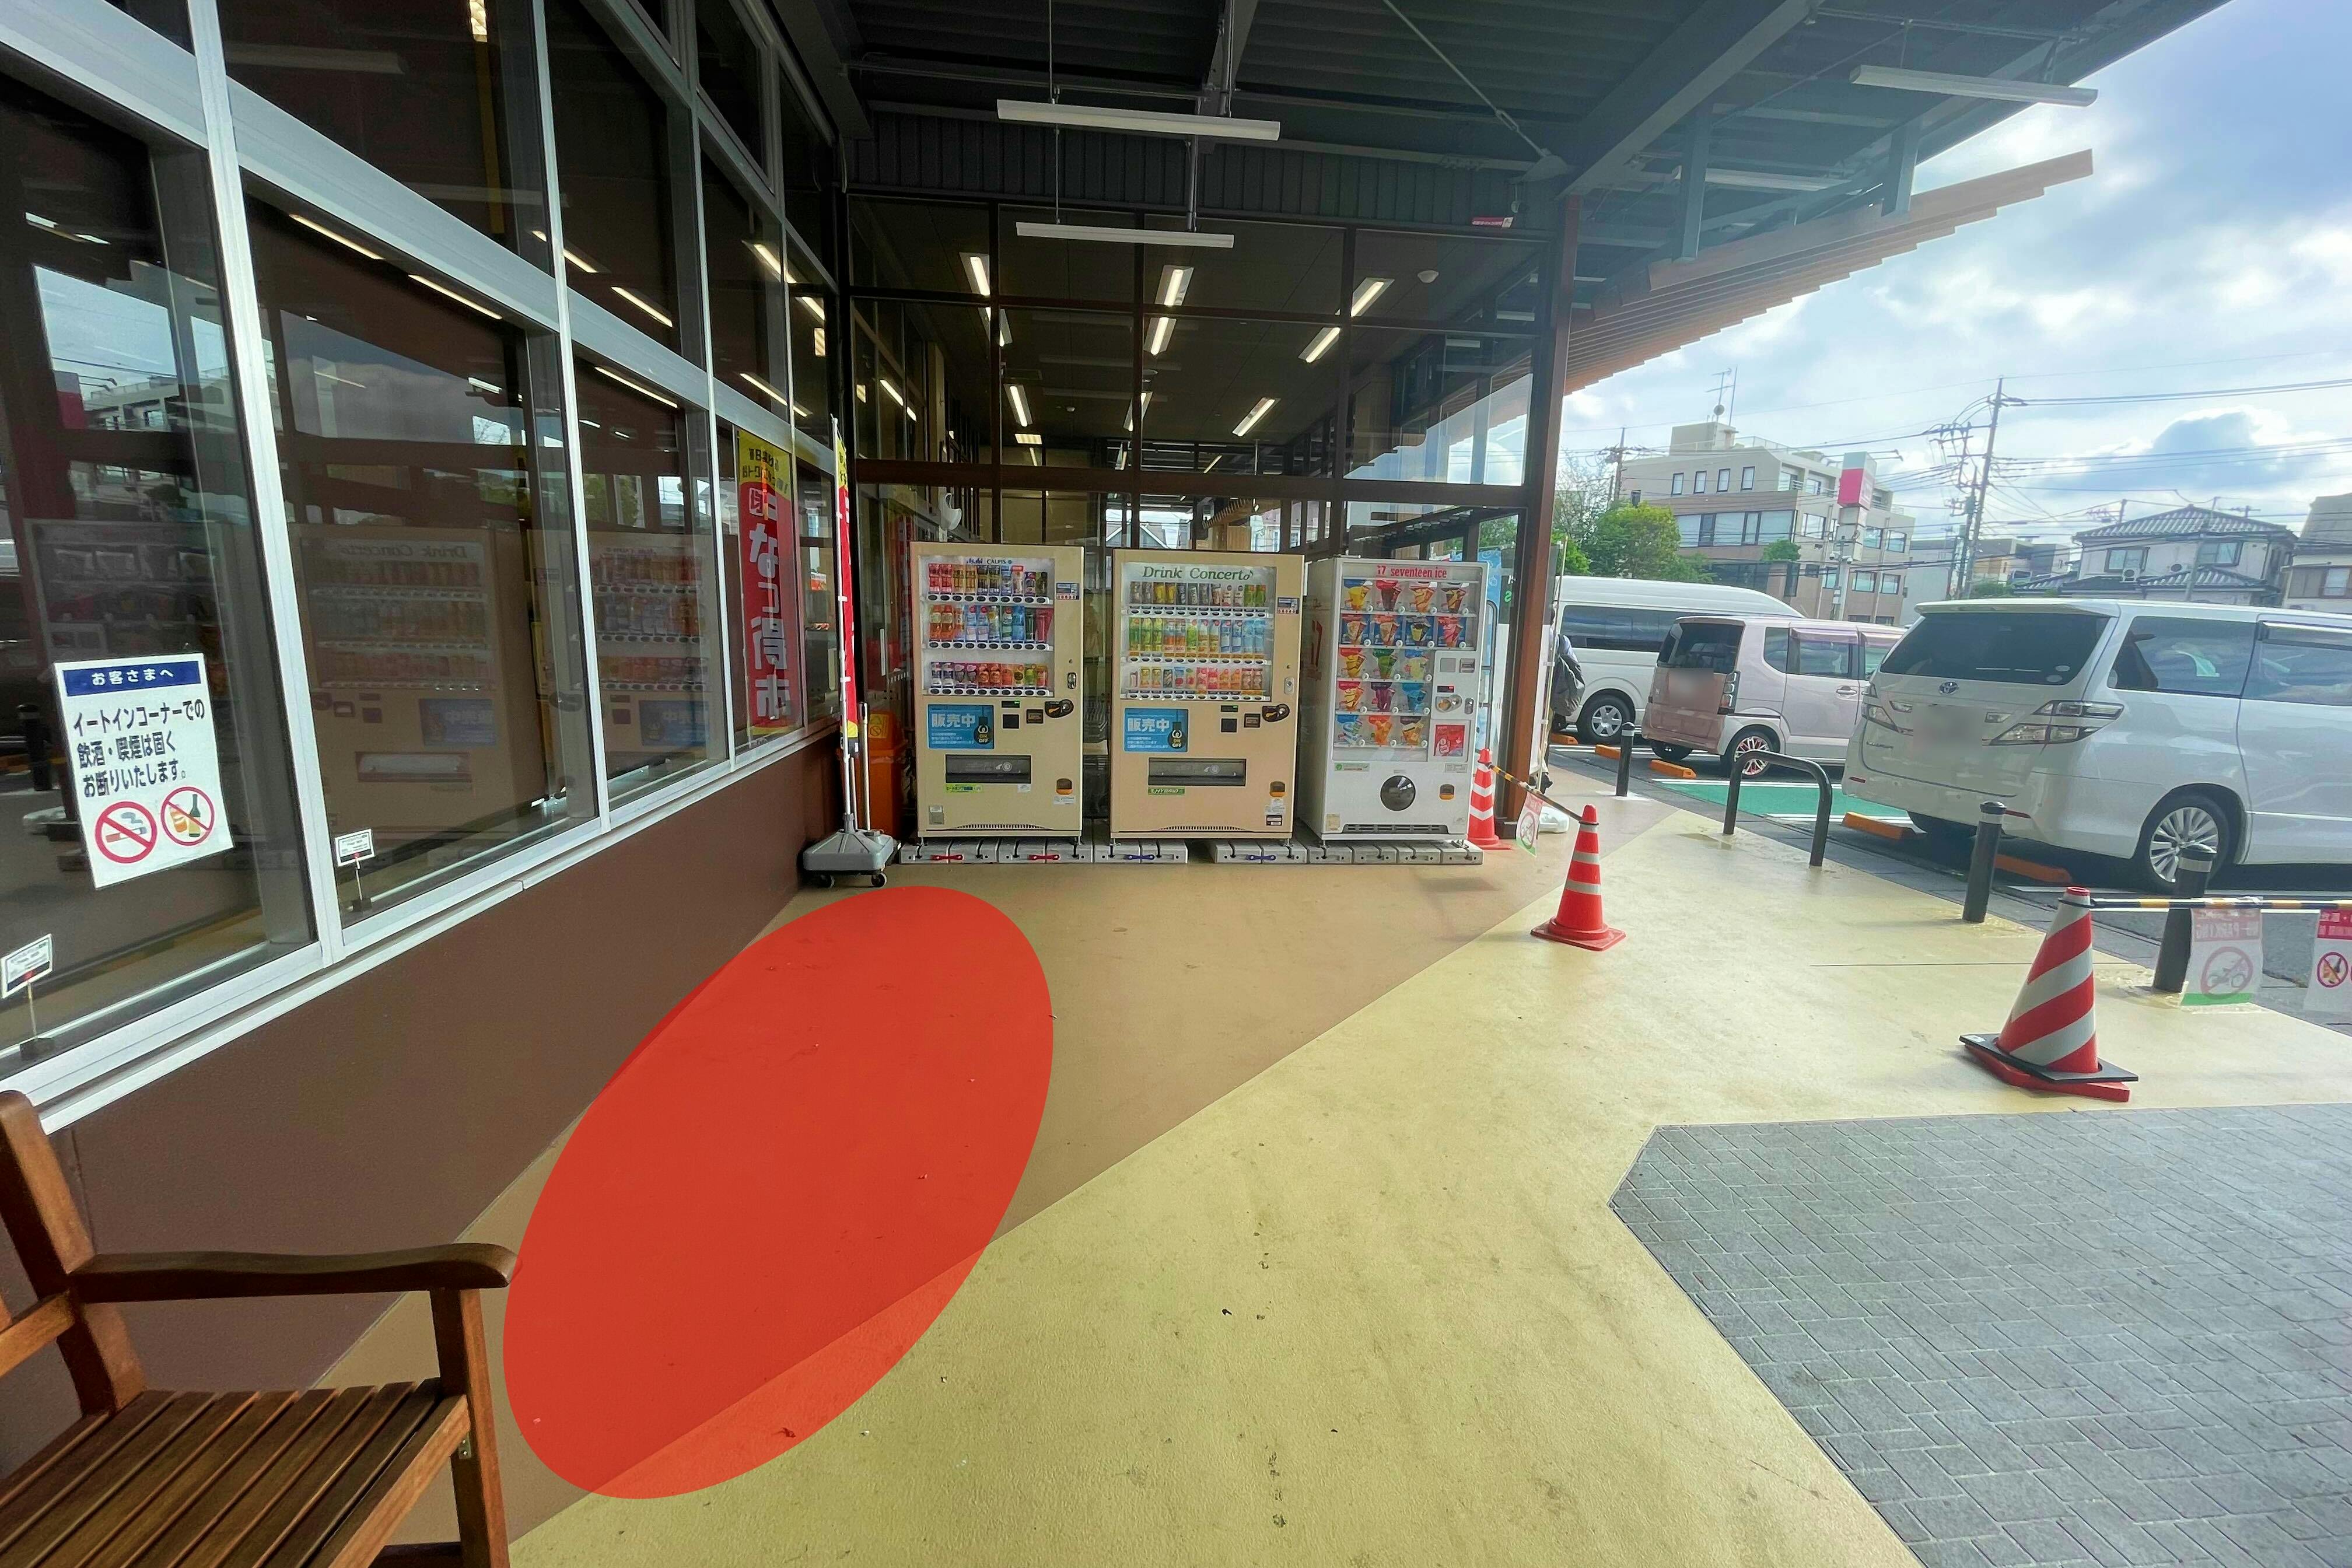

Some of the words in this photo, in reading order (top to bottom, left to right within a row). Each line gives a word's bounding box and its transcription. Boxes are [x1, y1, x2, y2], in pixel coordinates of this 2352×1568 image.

[1142, 566, 1182, 579] Drink
[1189, 567, 1251, 580] Concerto
[1390, 568, 1433, 579] seventeen
[1435, 566, 1447, 579] ice
[91, 668, 174, 687] お客さまへ
[73, 698, 205, 737] イートインコーナーでの
[932, 713, 975, 727] 販売中
[1127, 718, 1170, 732] 販売中
[76, 730, 176, 769] 飲酒・喫煙は固く
[83, 758, 186, 797] お断りいたします。
